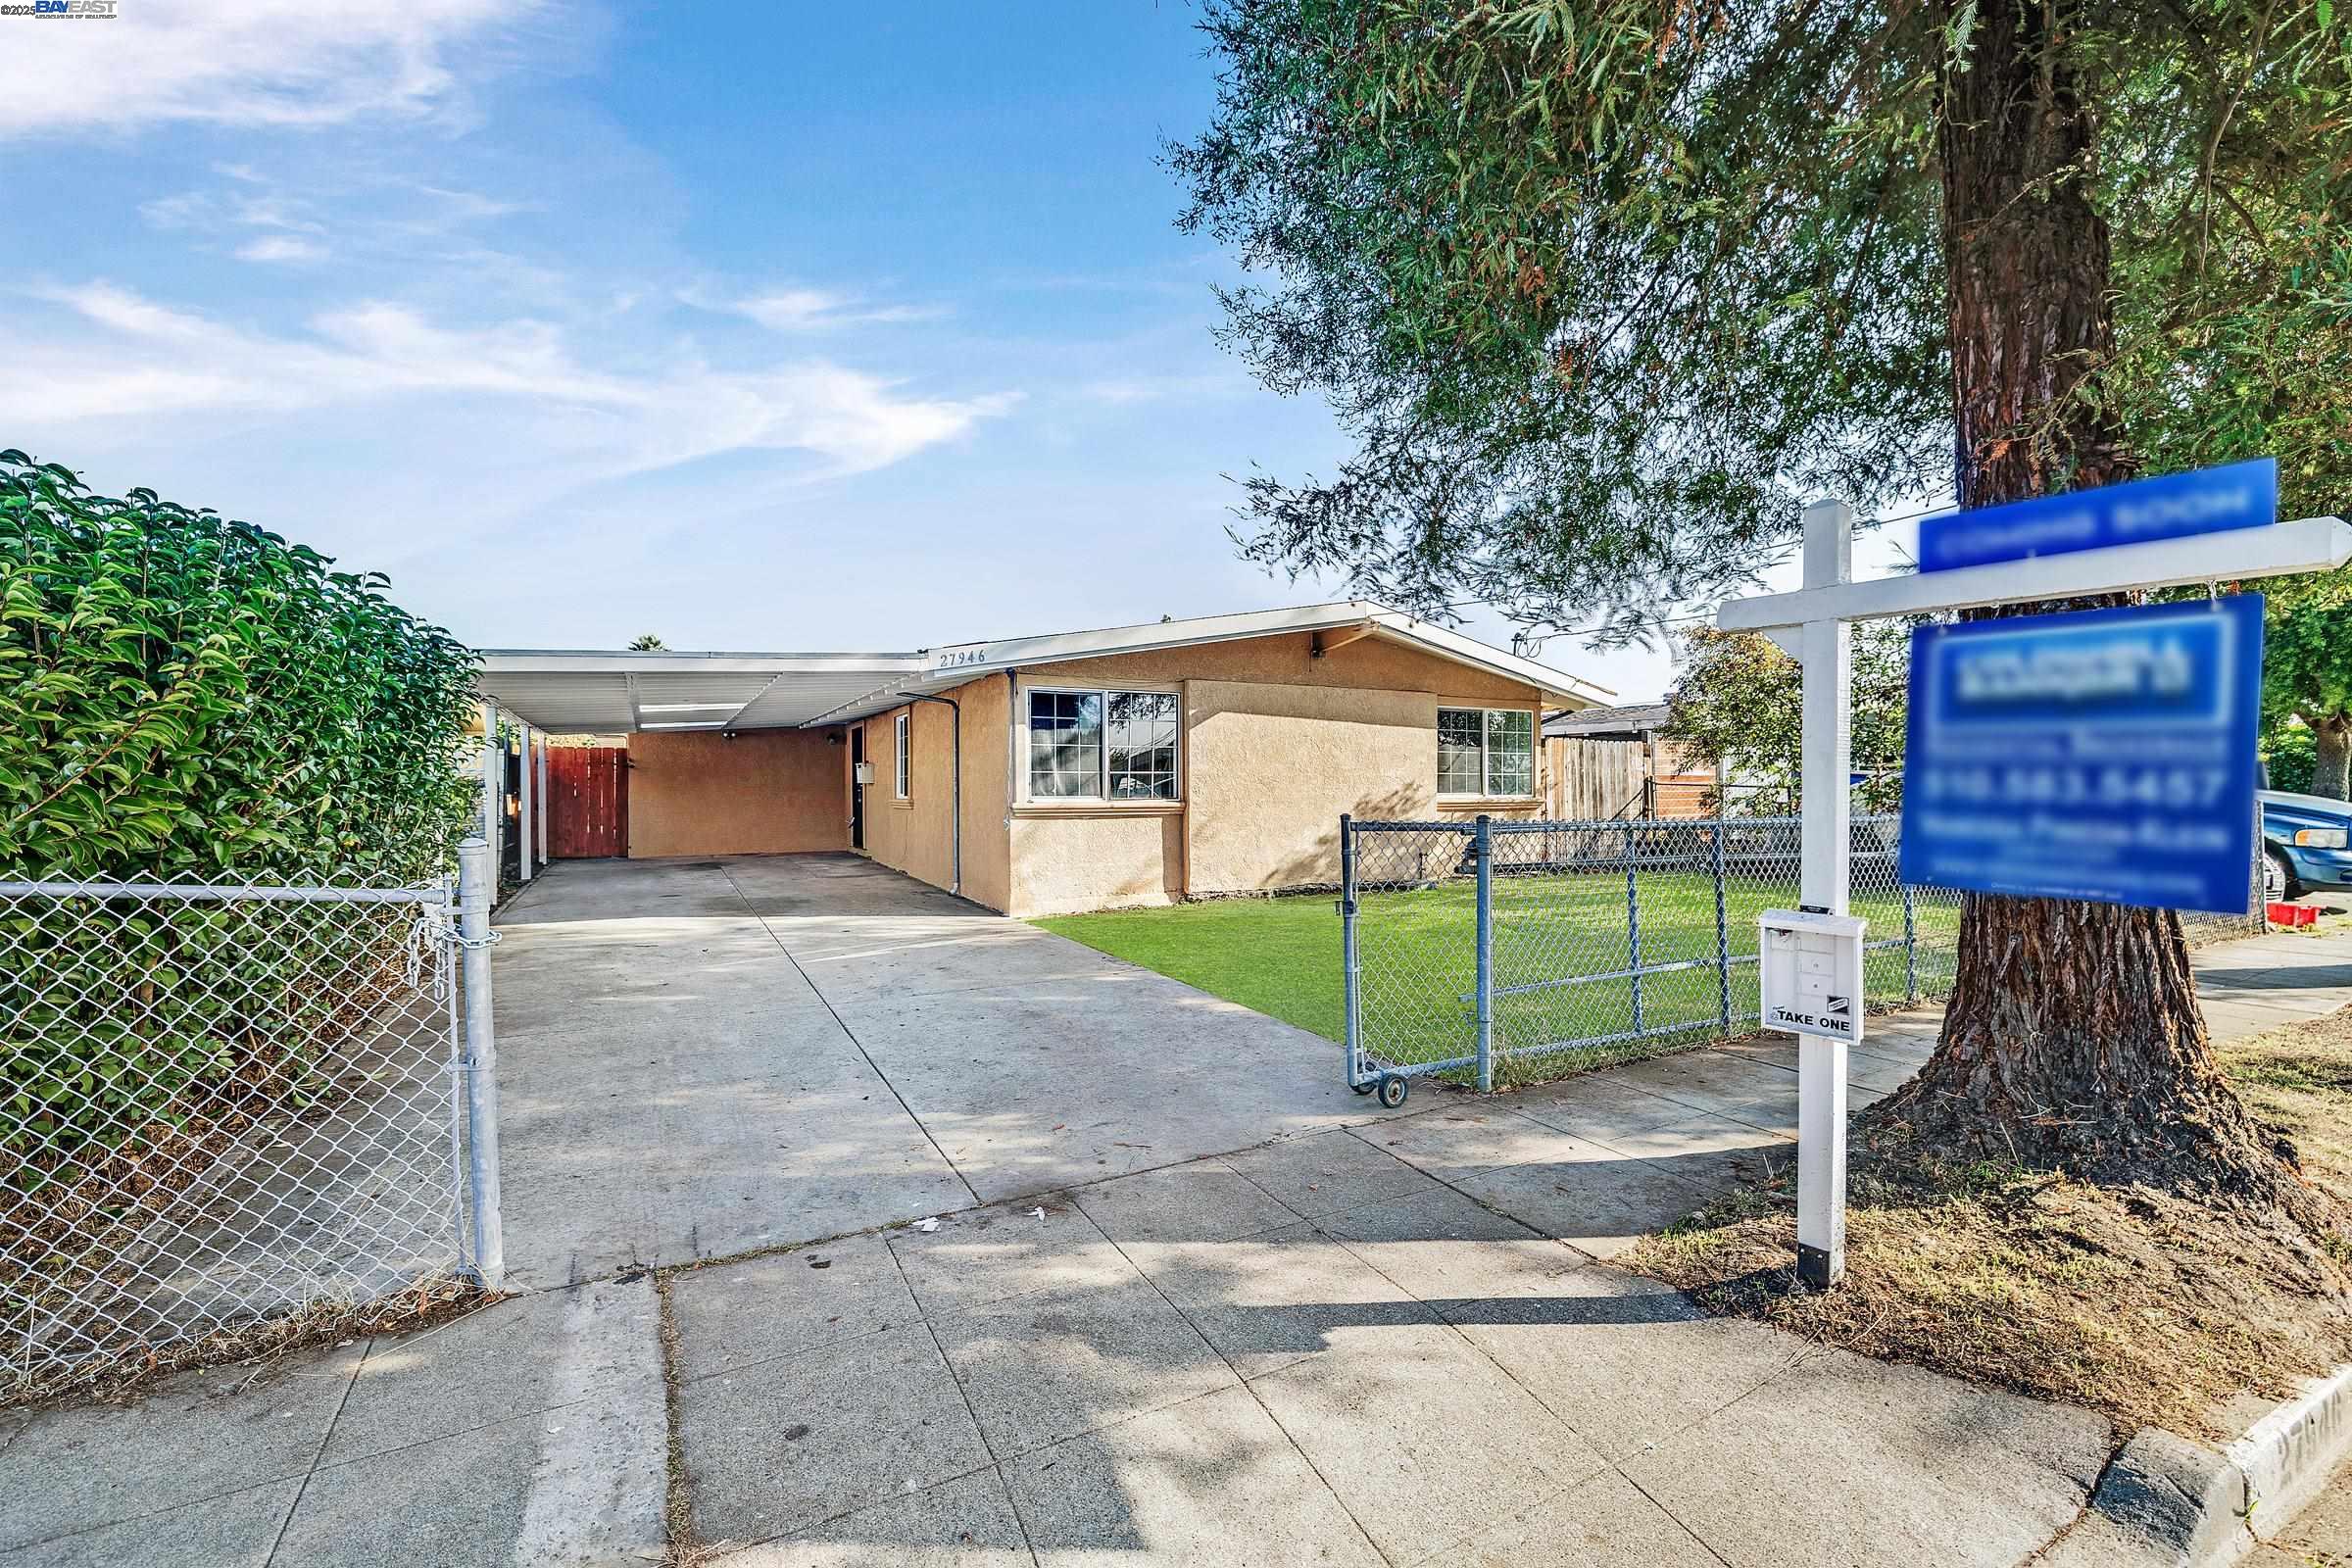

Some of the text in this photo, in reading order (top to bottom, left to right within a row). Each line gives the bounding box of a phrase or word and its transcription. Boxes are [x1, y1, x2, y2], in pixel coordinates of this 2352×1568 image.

[941, 649, 985, 667] 27946
[1777, 1010, 1850, 1032] TAKE ONE
